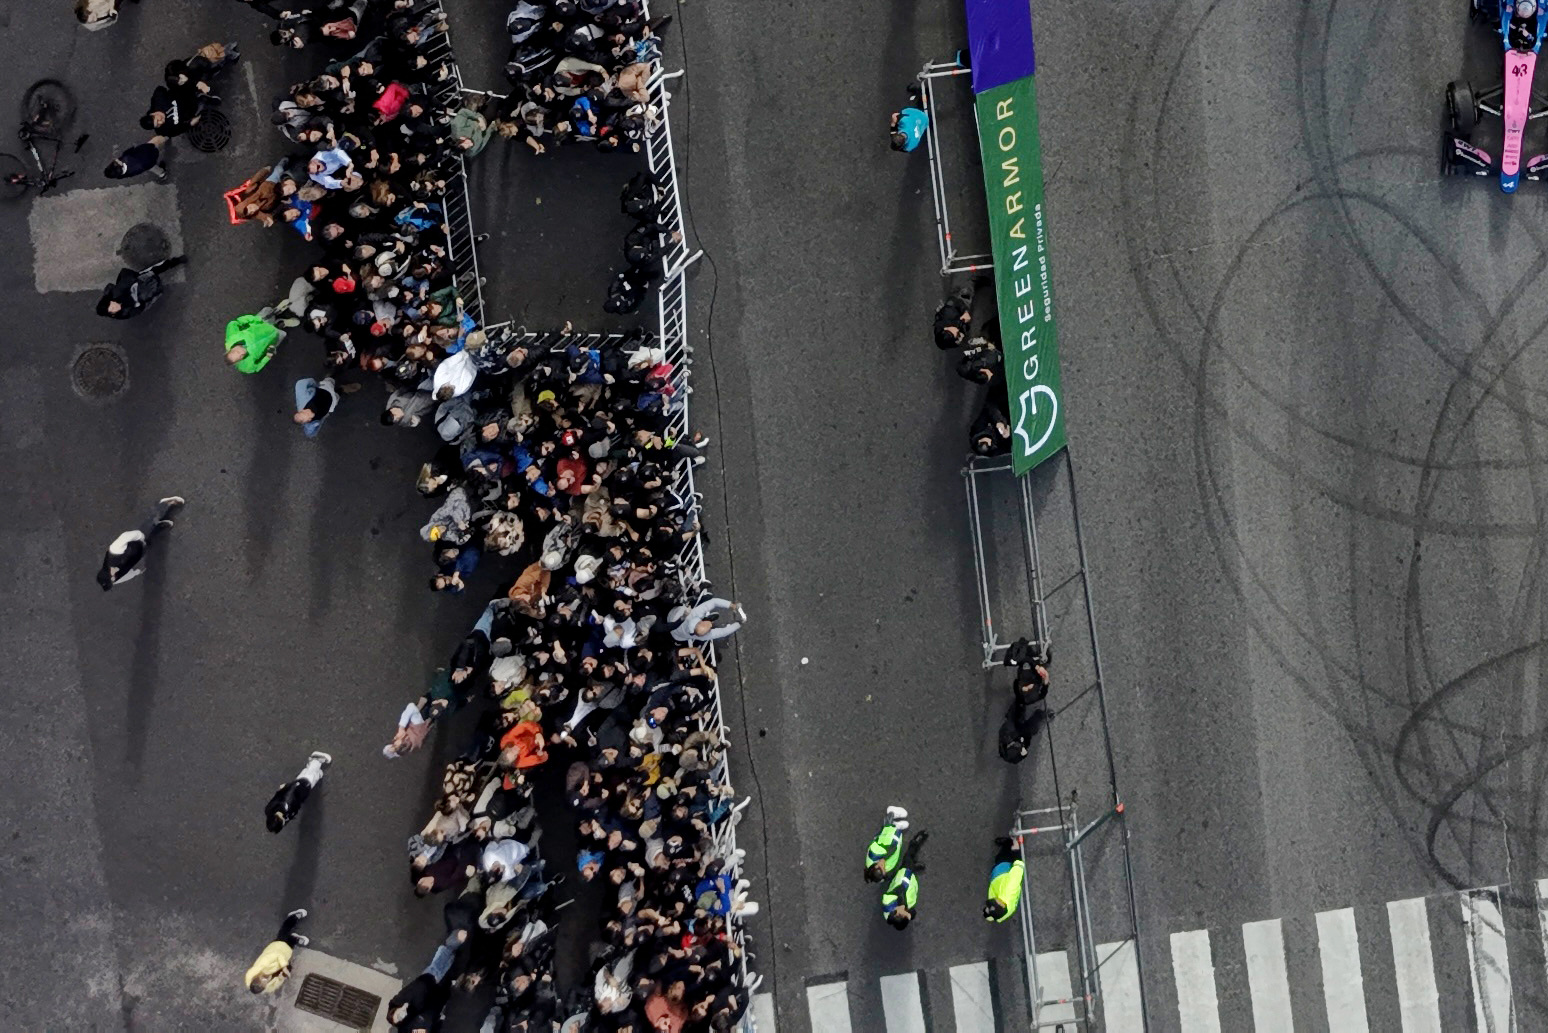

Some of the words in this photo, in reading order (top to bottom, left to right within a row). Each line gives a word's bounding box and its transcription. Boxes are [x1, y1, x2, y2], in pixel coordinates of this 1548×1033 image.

[1512, 64, 1528, 77] 43
[996, 97, 1039, 380] GREENARMOR
[1034, 203, 1045, 251] Privada
[1039, 255, 1051, 322] Seguridad
